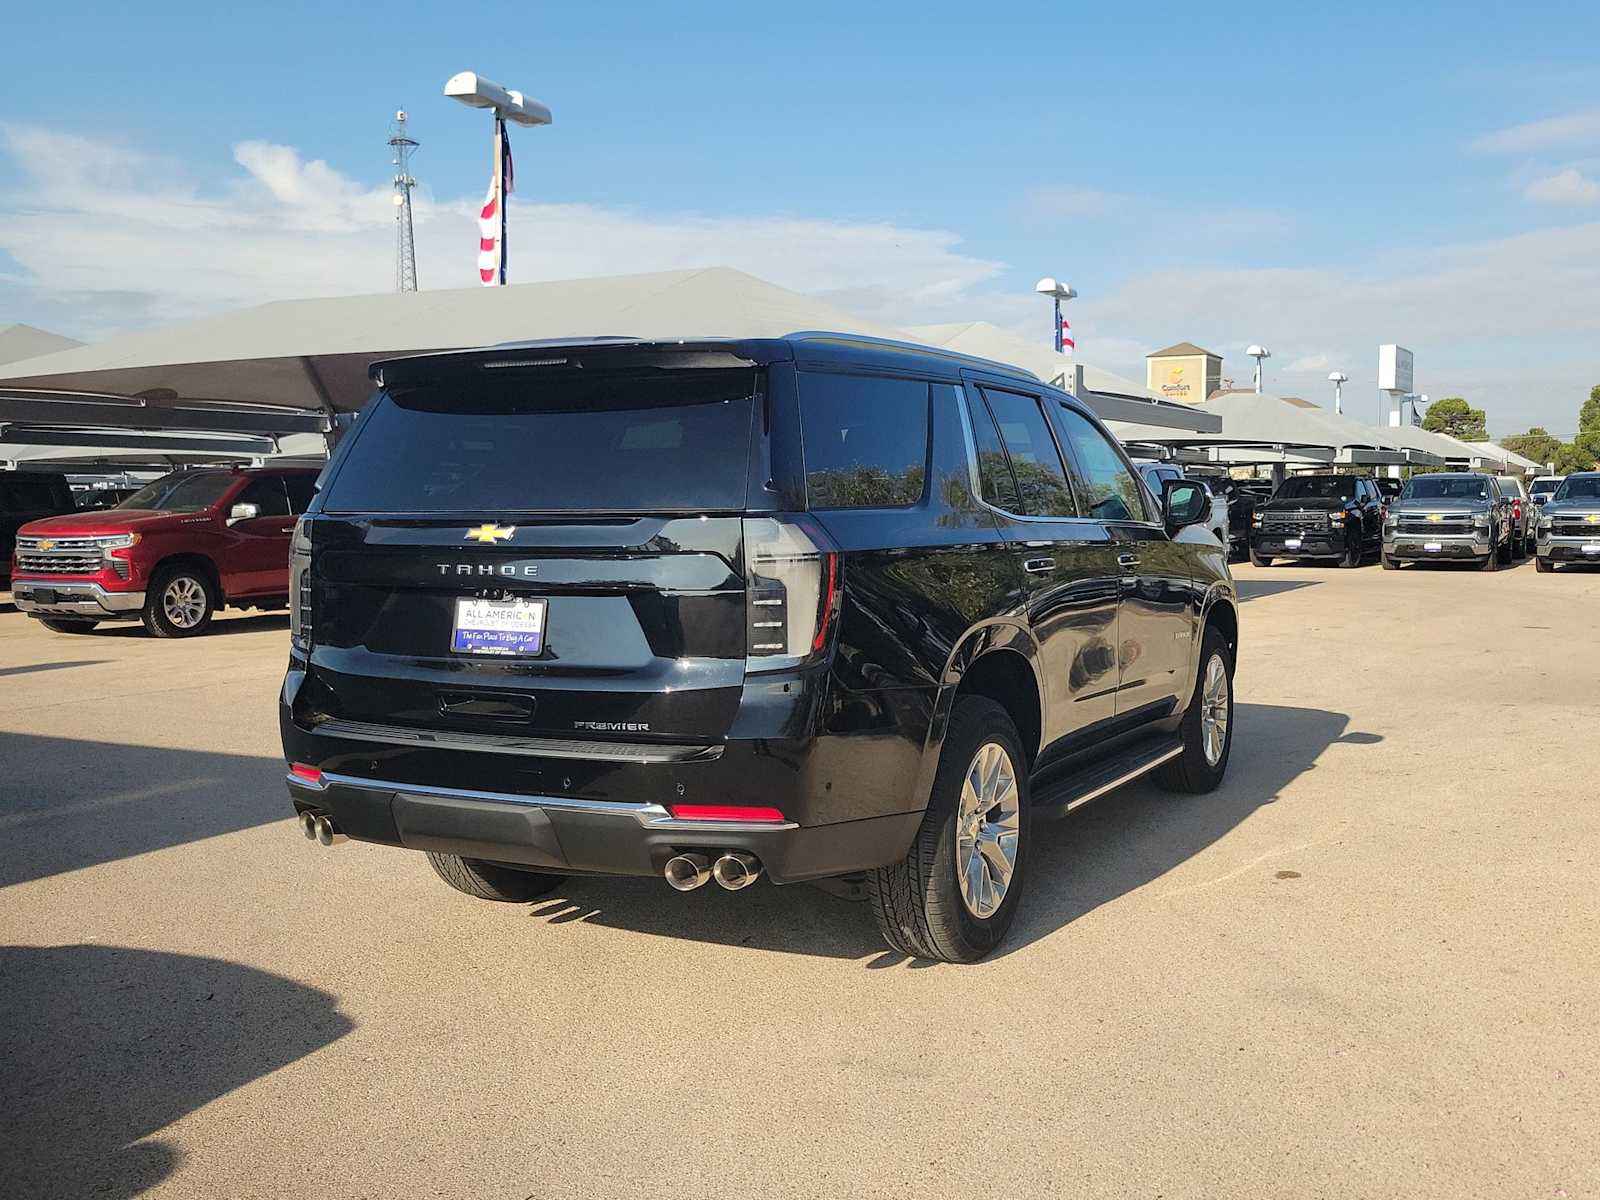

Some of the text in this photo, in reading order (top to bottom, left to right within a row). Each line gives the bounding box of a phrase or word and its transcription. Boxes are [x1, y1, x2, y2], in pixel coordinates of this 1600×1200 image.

[436, 564, 538, 576] TAHOE
[465, 609, 483, 618] ALL
[574, 721, 651, 731] PREMIER
